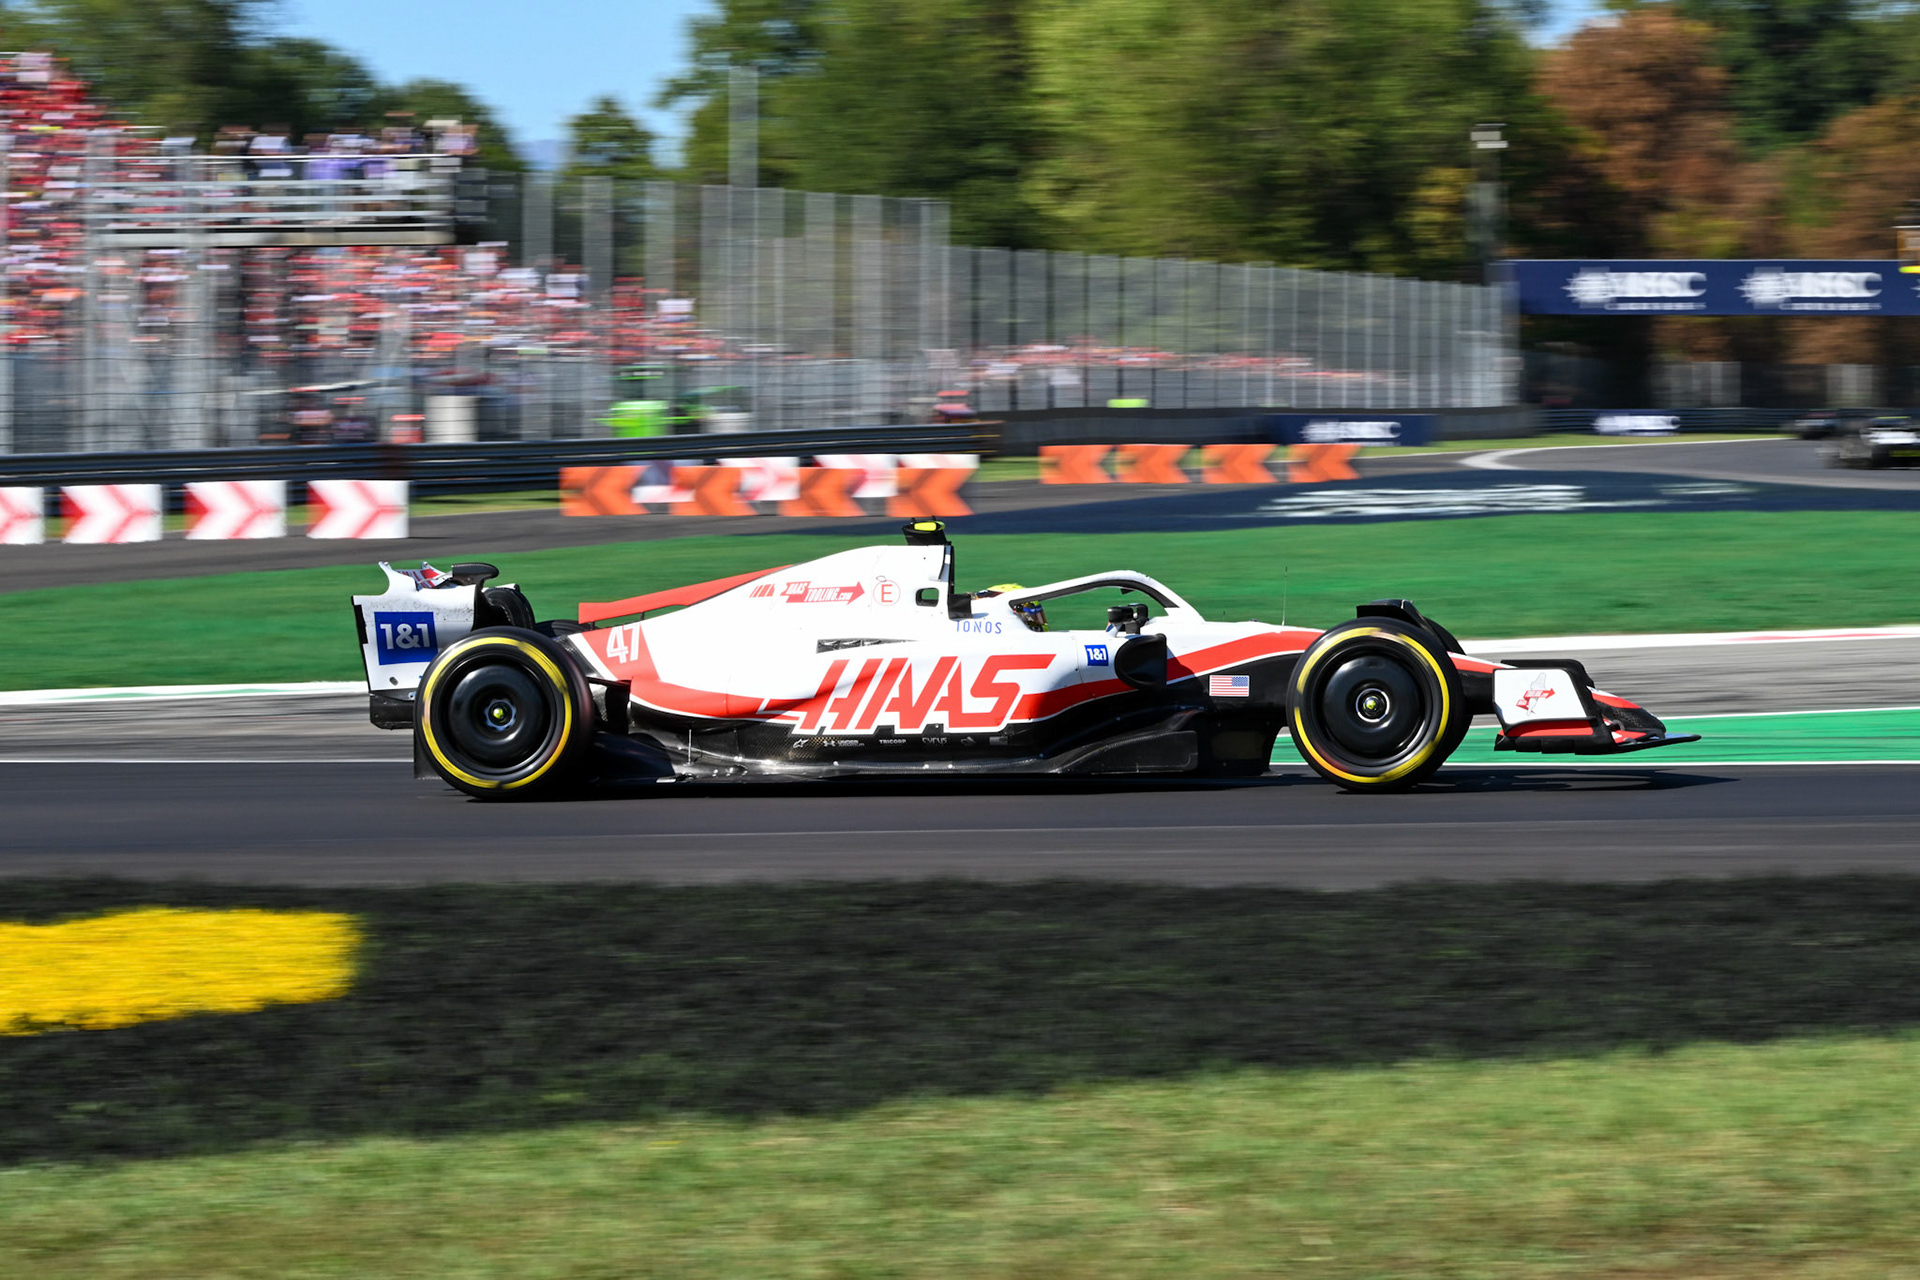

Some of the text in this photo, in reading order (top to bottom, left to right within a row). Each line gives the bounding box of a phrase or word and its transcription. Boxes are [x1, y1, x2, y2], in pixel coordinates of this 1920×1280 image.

[881, 584, 893, 603] E
[380, 623, 431, 650] 1&1
[956, 620, 1002, 634] IONOS
[606, 622, 641, 664] 47
[1086, 647, 1107, 661] 1&1
[796, 653, 1057, 730] HAAS
